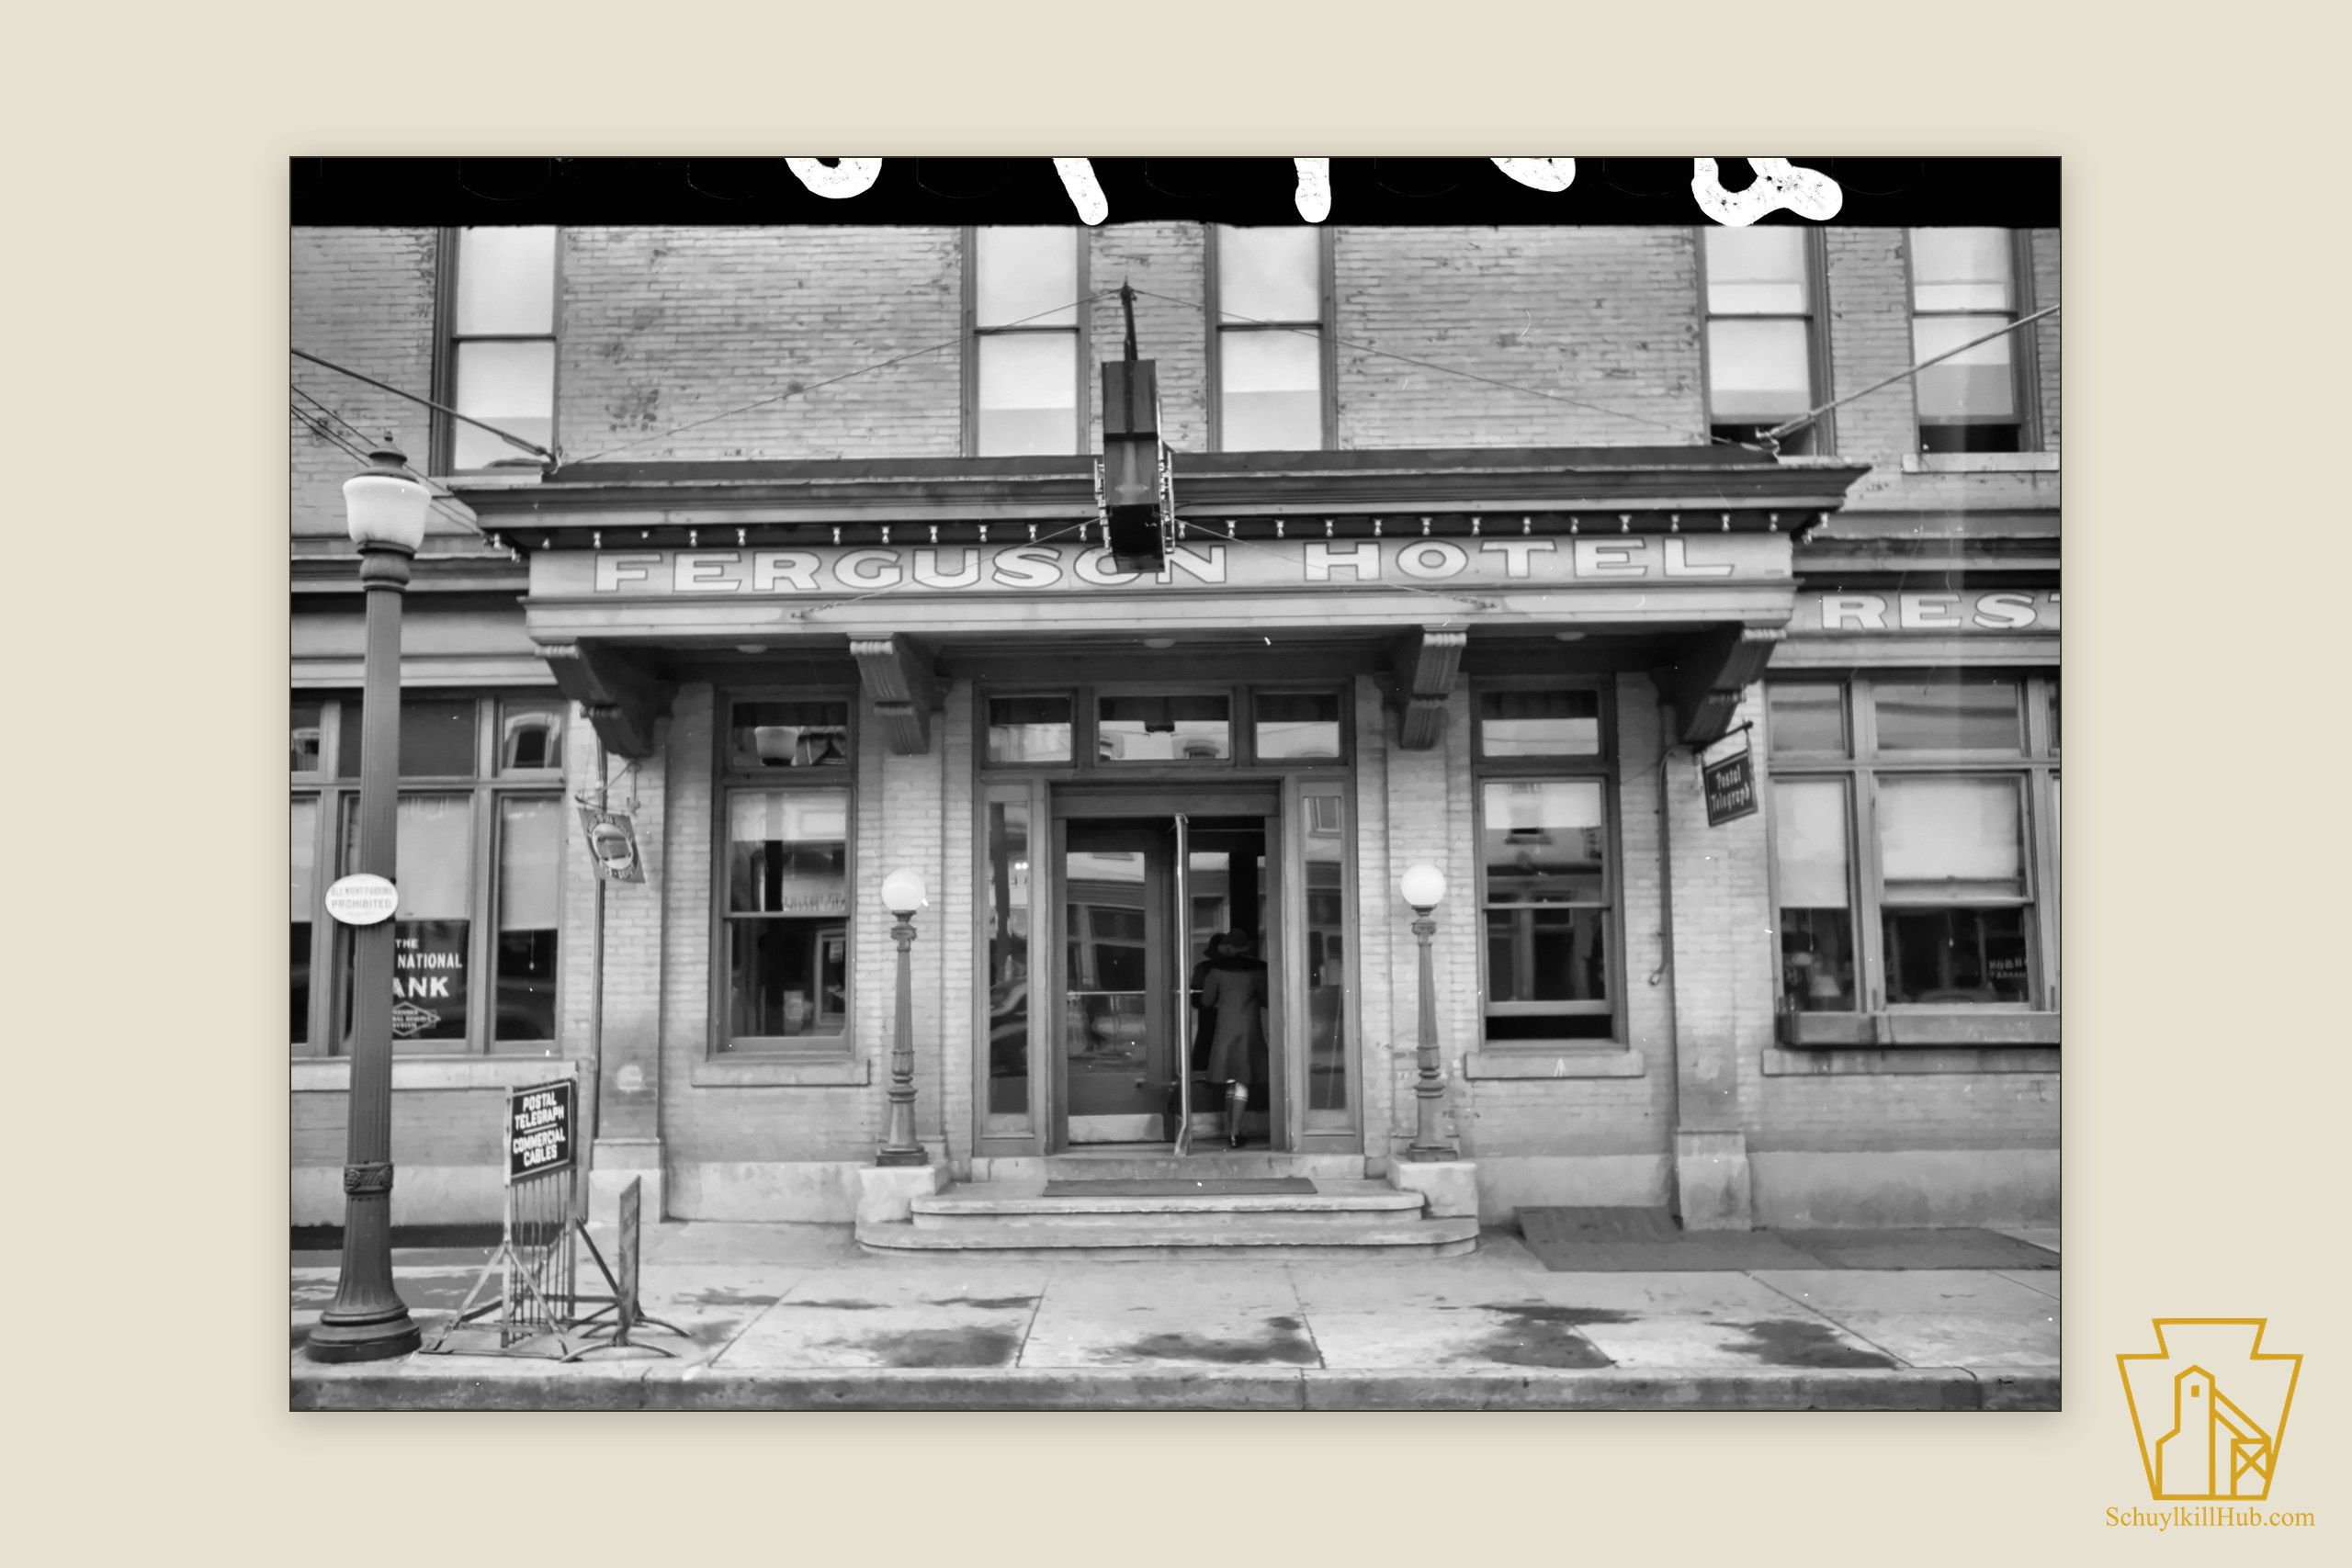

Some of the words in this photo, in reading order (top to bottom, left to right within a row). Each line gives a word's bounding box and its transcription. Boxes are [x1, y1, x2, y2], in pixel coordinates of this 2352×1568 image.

[594, 544, 1227, 592] FERGUSON
[1303, 537, 1736, 582] HOTEL
[1822, 592, 2061, 630] RES
[1715, 764, 1741, 790] Postal
[1711, 781, 1751, 812] Telegraph
[331, 898, 392, 908] PROHIBITED
[394, 938, 419, 949] THE
[397, 952, 463, 970] NATIONAL
[392, 976, 450, 999] ANK
[522, 1091, 557, 1112] POSTAL
[514, 1105, 565, 1131] TELEGRAPH
[513, 1127, 566, 1155] COMMERCIAL
[523, 1144, 558, 1168] CABLES
